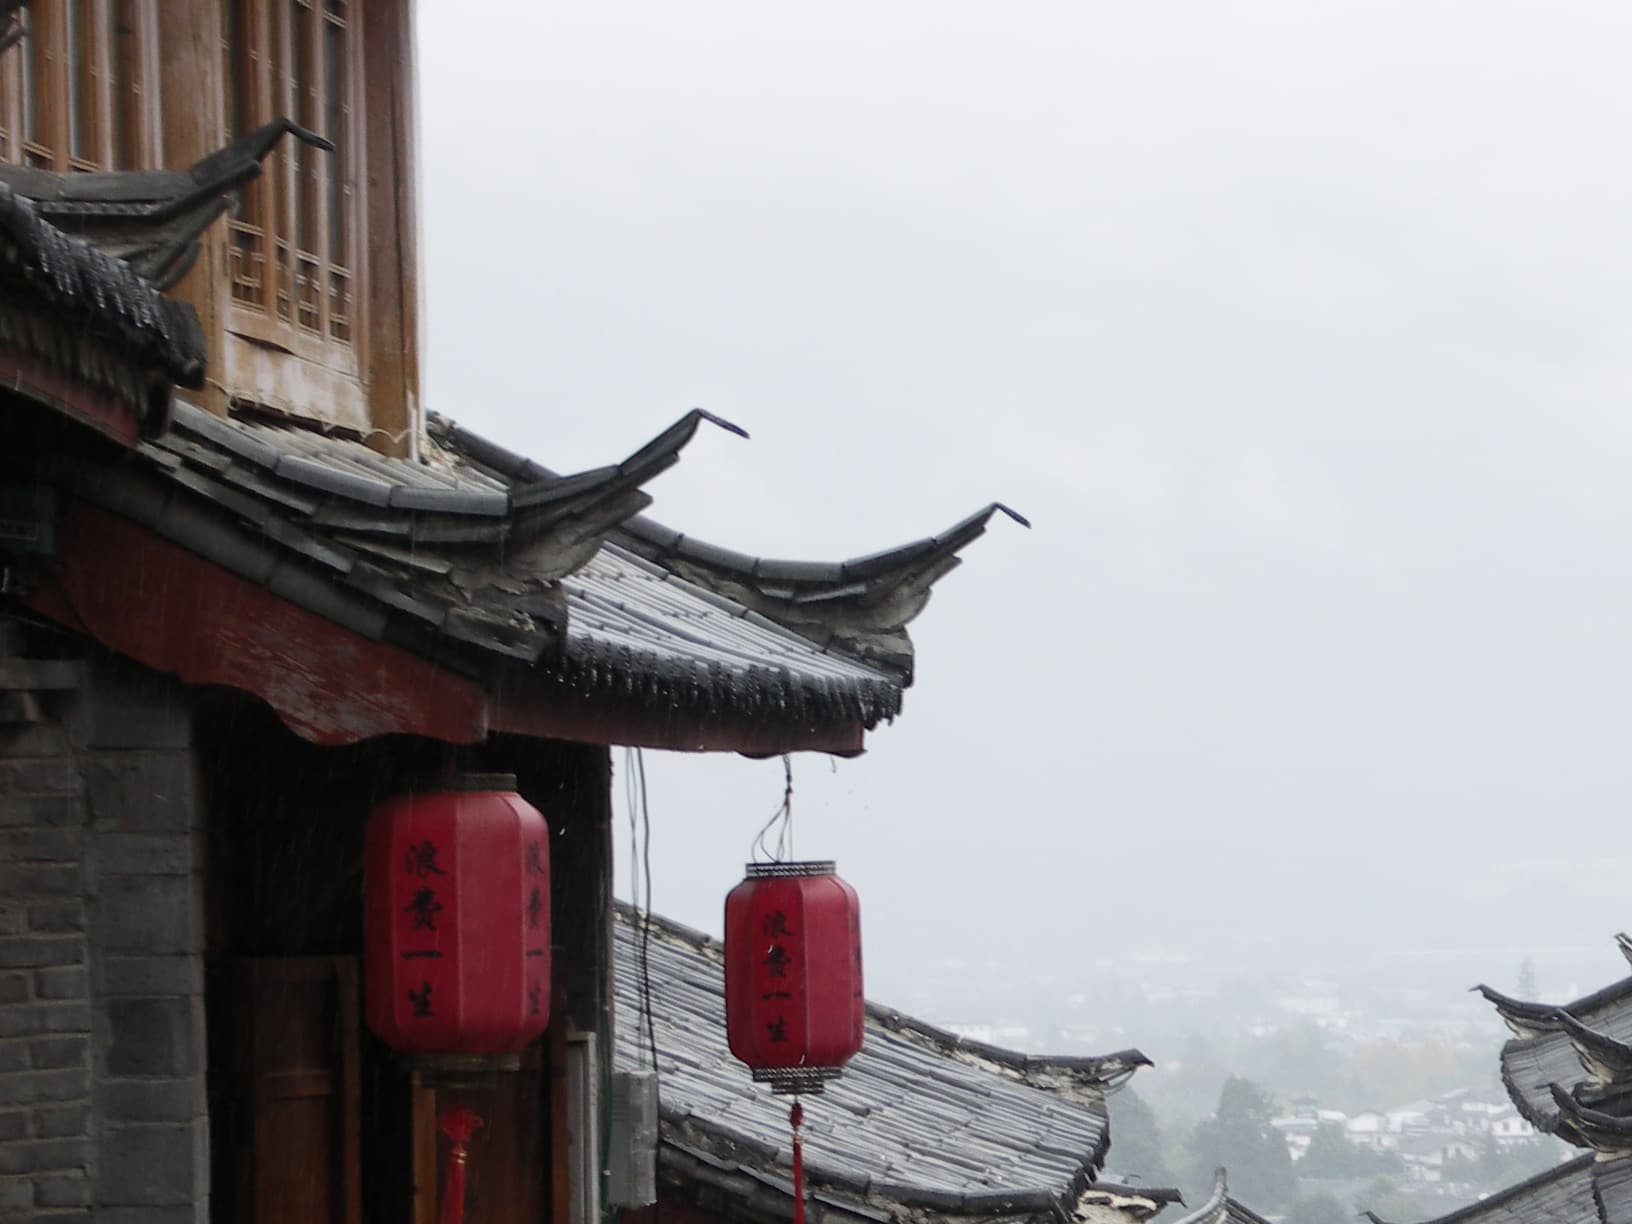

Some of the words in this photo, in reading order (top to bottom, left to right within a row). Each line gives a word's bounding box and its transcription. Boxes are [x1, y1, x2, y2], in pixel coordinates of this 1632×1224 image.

[402, 839, 447, 1018] 浪费一生
[761, 911, 793, 1044] 浪费一生
